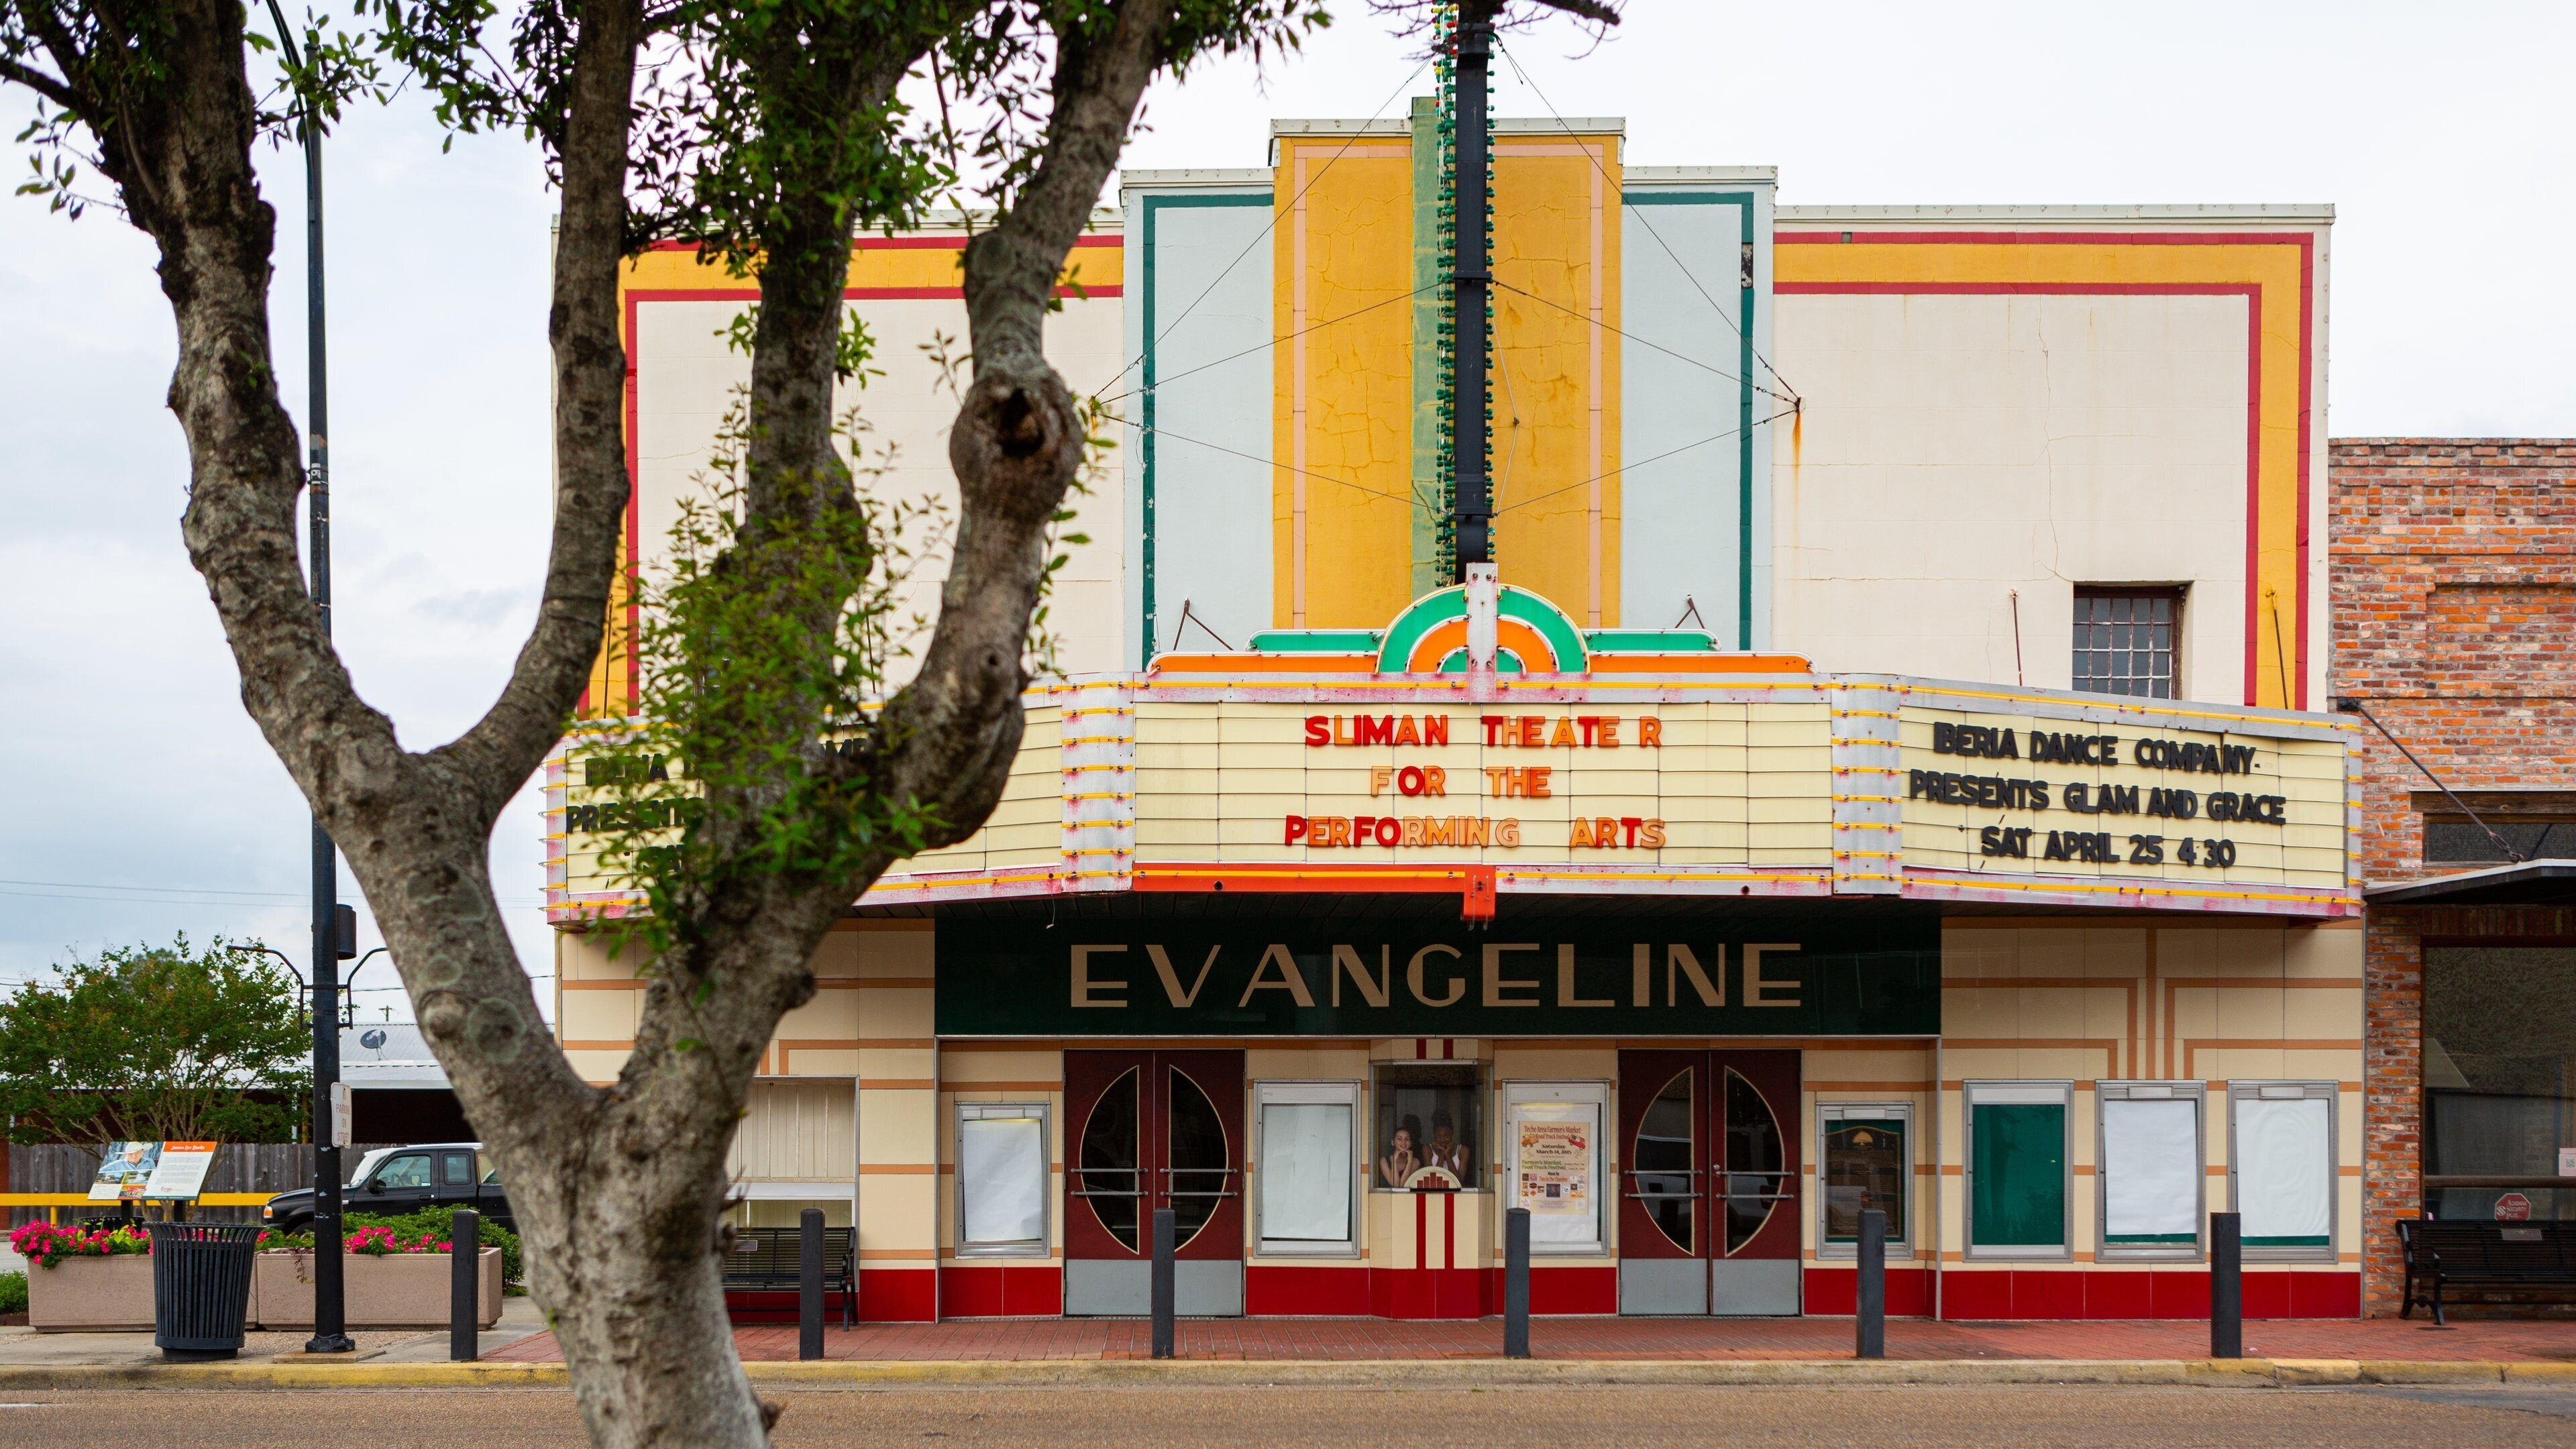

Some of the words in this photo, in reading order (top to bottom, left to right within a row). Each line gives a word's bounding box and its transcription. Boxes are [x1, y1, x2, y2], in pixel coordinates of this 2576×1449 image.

[1305, 714, 1448, 746] SLIMAN
[1934, 722, 2019, 759] BERIA
[2030, 731, 2118, 765] DANCE
[1371, 765, 1446, 796] FOR
[1486, 766, 1551, 797] THE
[1910, 769, 2049, 810] PRESENTS
[2063, 782, 2139, 814] GLAM
[2147, 787, 2198, 819] AND
[2206, 792, 2286, 824] GRACE
[1285, 815, 1519, 848] PERFORMING
[1570, 816, 1666, 848] ARTS
[1981, 826, 2032, 858] SAT
[2044, 830, 2120, 863] APRIL
[2129, 834, 2163, 864] 25
[1071, 943, 1801, 1007] EVANGELINE
